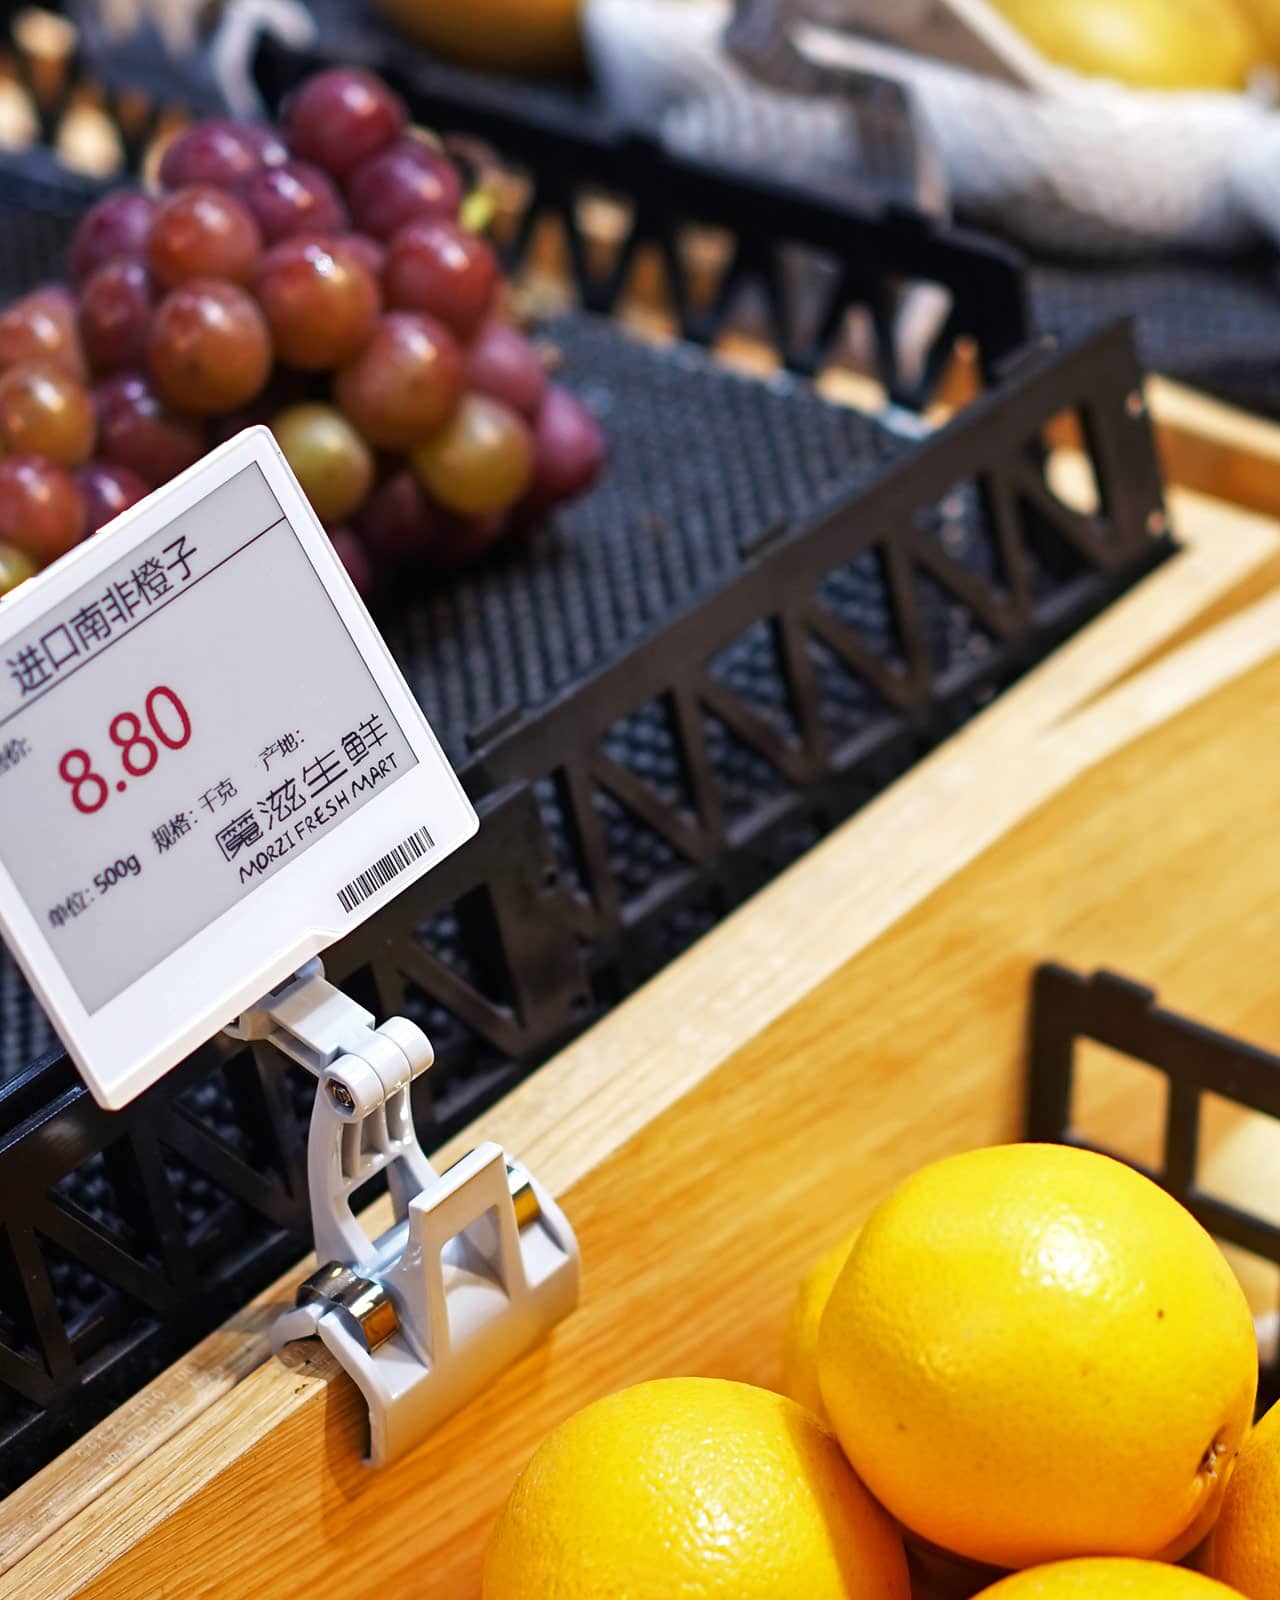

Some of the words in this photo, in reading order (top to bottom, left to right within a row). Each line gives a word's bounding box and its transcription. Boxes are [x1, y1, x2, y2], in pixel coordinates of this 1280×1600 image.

[6, 535, 198, 697] 进口南非橙子
[58, 685, 192, 815] 8.80
[238, 834, 296, 884] MORZI
[294, 790, 351, 841] FRESH
[351, 752, 398, 798] MART
